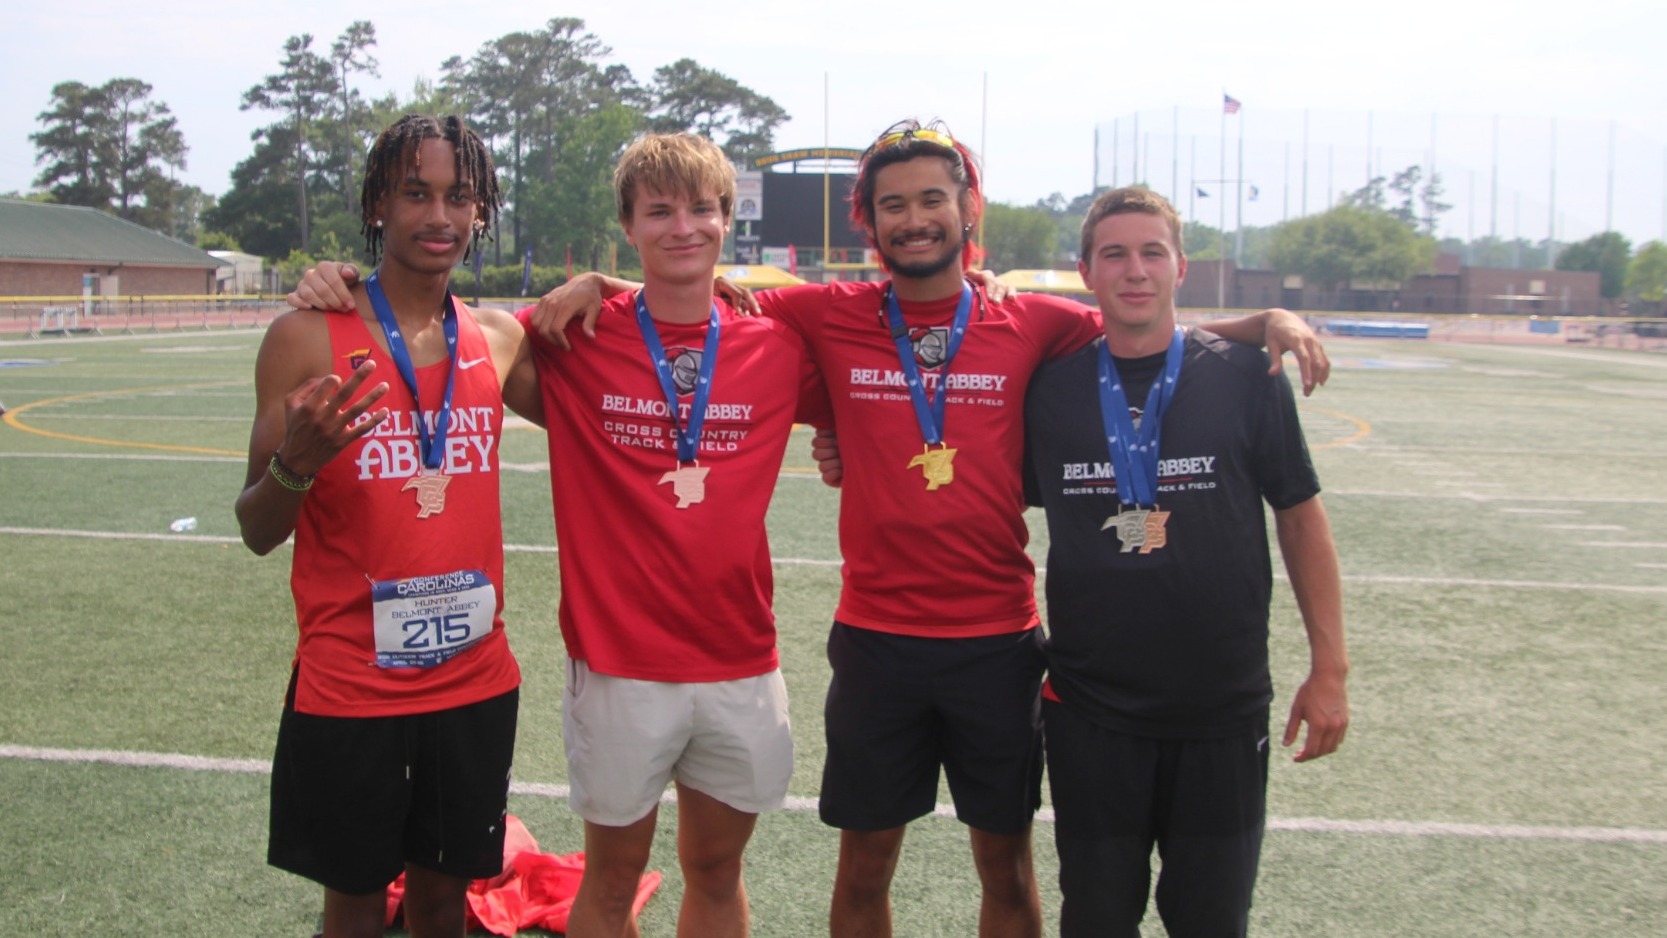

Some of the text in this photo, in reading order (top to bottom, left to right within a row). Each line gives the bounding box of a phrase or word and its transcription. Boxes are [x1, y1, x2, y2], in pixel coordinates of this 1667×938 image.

[945, 373, 1007, 391] ABBEY
[850, 392, 880, 400] CROSS
[977, 398, 1004, 406] FIELD
[604, 421, 748, 440] CROSS CNTRY
[611, 433, 665, 449] TRACK
[700, 441, 738, 452] IELD
[355, 435, 494, 480] ABEY
[1063, 456, 1216, 480] BELM ABBEY
[1188, 482, 1217, 490] FIELD
[397, 573, 475, 596] CAROLINAS
[413, 571, 464, 584] CONFERENCE
[391, 600, 480, 619] BELMONT ABBEY
[415, 596, 458, 608] HUNTER
[402, 612, 471, 649] 215
